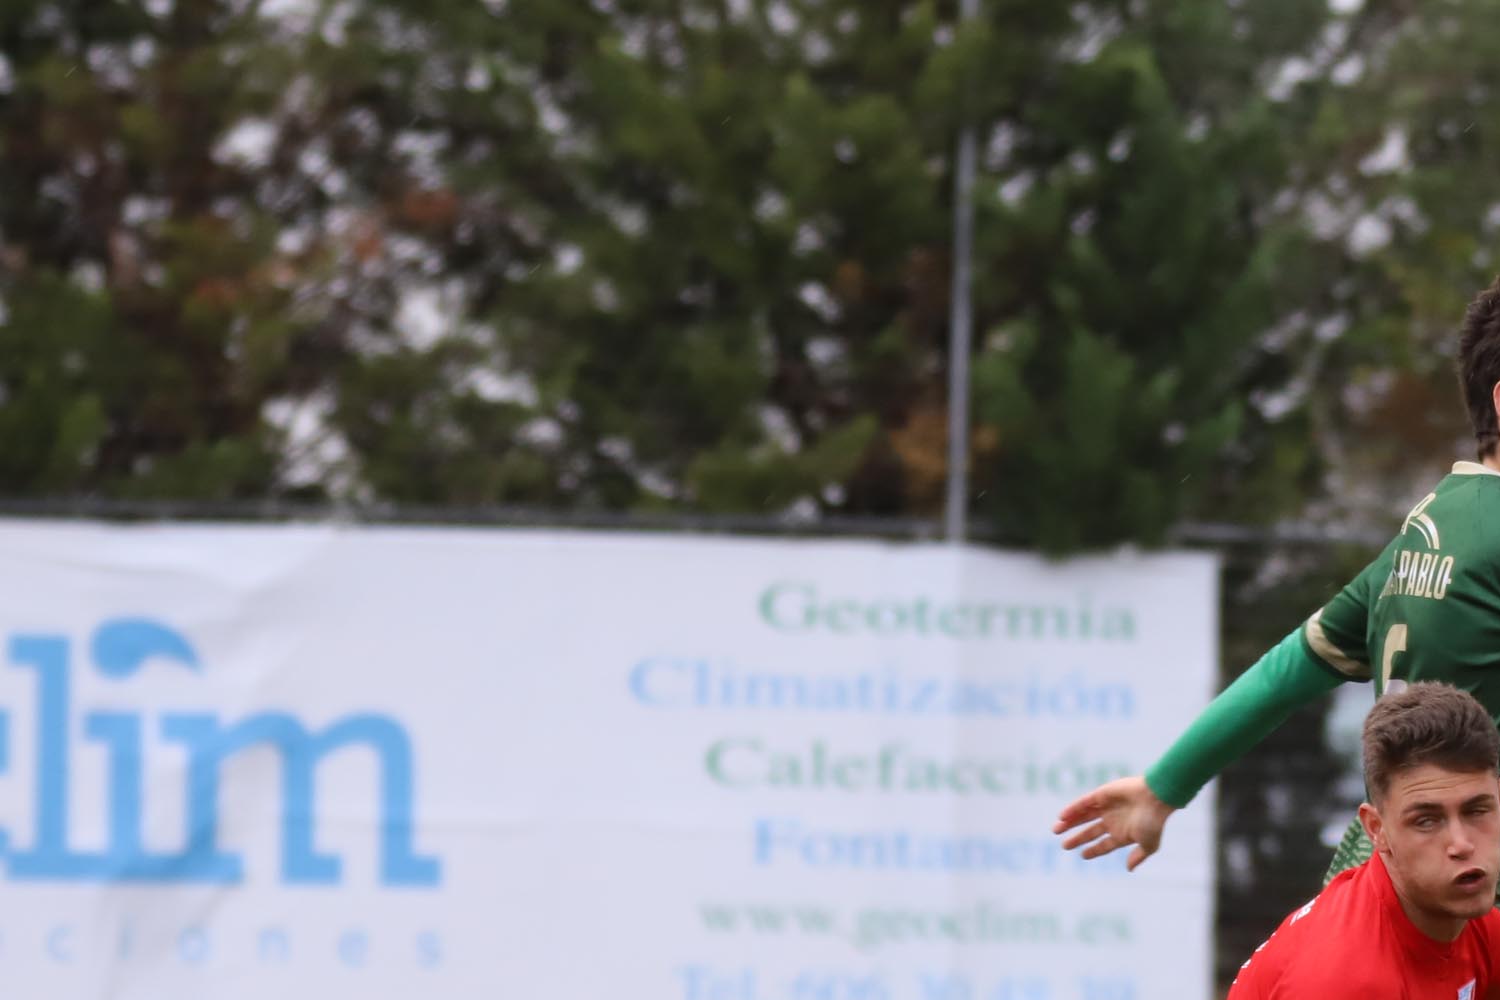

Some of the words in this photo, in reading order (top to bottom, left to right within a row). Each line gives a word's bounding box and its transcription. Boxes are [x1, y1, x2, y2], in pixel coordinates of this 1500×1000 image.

[1398, 549, 1454, 600] PABLO
[759, 580, 1136, 640] Geotermia
[629, 656, 1136, 718] Climatización
[0, 613, 443, 889] lim
[704, 738, 1134, 794] Calefacción
[0, 914, 444, 968] ciones
